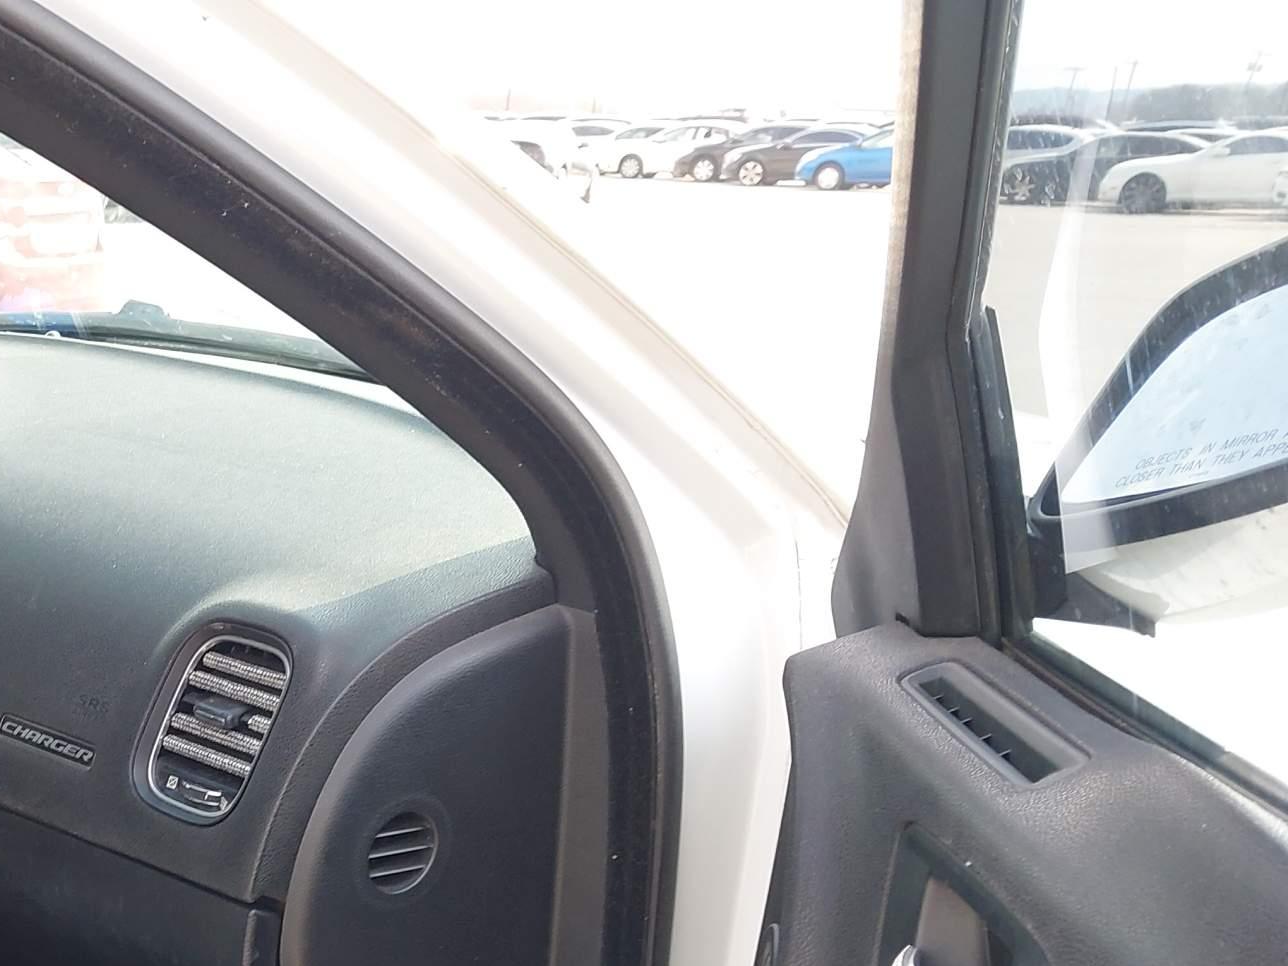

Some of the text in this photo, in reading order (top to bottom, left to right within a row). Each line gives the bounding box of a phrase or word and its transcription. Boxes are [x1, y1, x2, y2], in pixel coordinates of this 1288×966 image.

[1114, 466, 1164, 489] CLOSER
[1169, 457, 1207, 476] THAN
[1214, 449, 1250, 466] THEY
[1135, 447, 1193, 470] OBJECTS
[1200, 441, 1216, 454] IN
[1221, 428, 1279, 450] MIRROR
[1, 720, 94, 762] CHARGER
